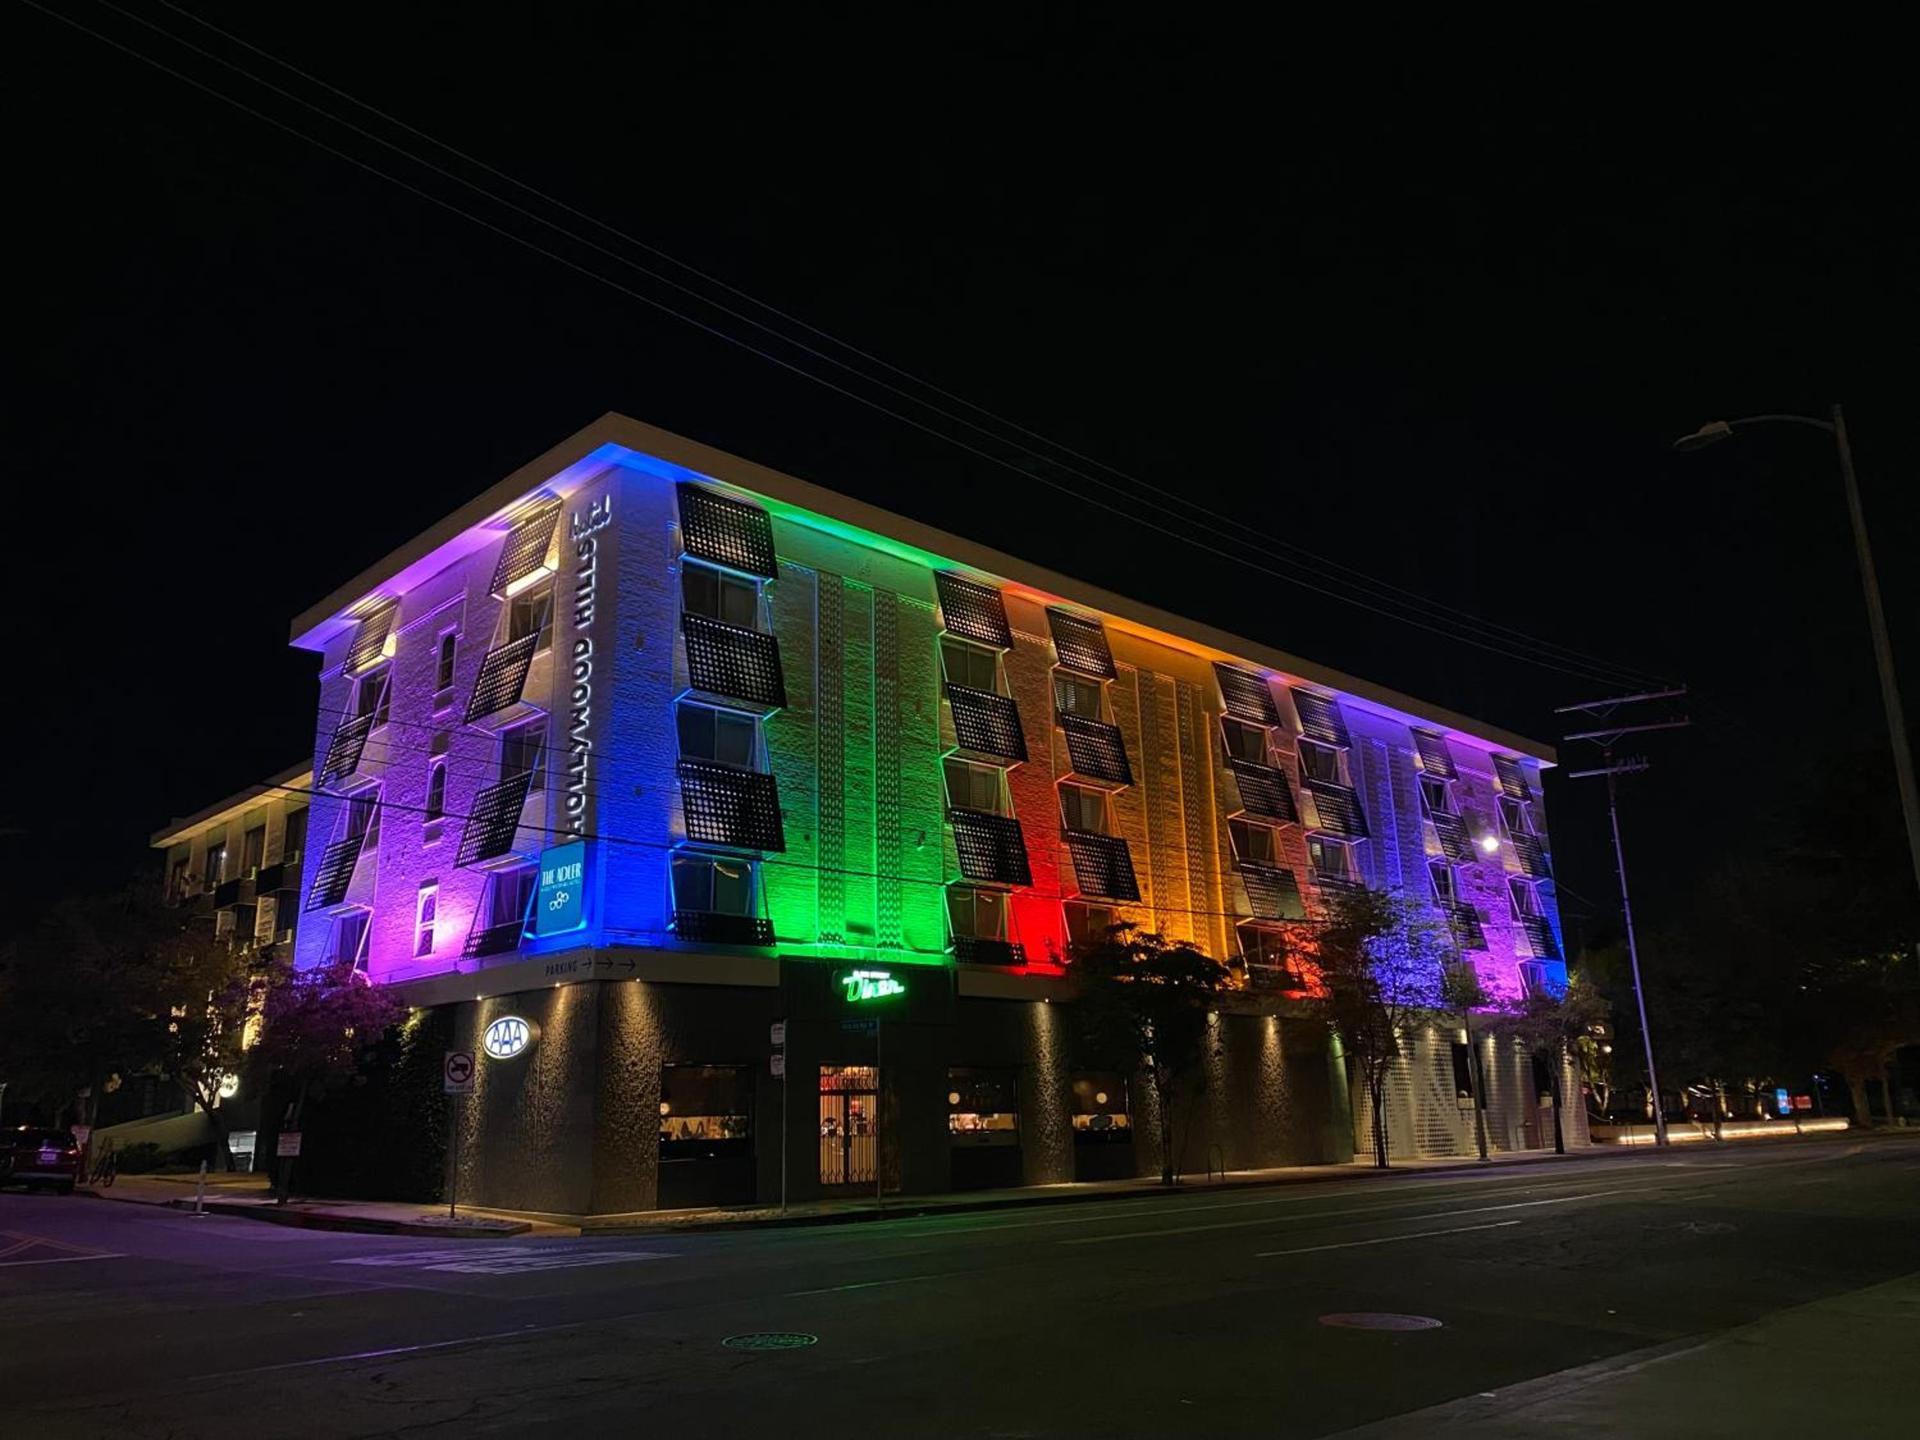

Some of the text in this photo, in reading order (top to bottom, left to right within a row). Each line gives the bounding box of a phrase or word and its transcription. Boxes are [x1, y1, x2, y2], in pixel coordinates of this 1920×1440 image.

[565, 538, 597, 839] HOLLYWOOD HILLS
[542, 868, 555, 886] THE
[544, 961, 578, 976] PARKING
[489, 1020, 524, 1055] AAA
